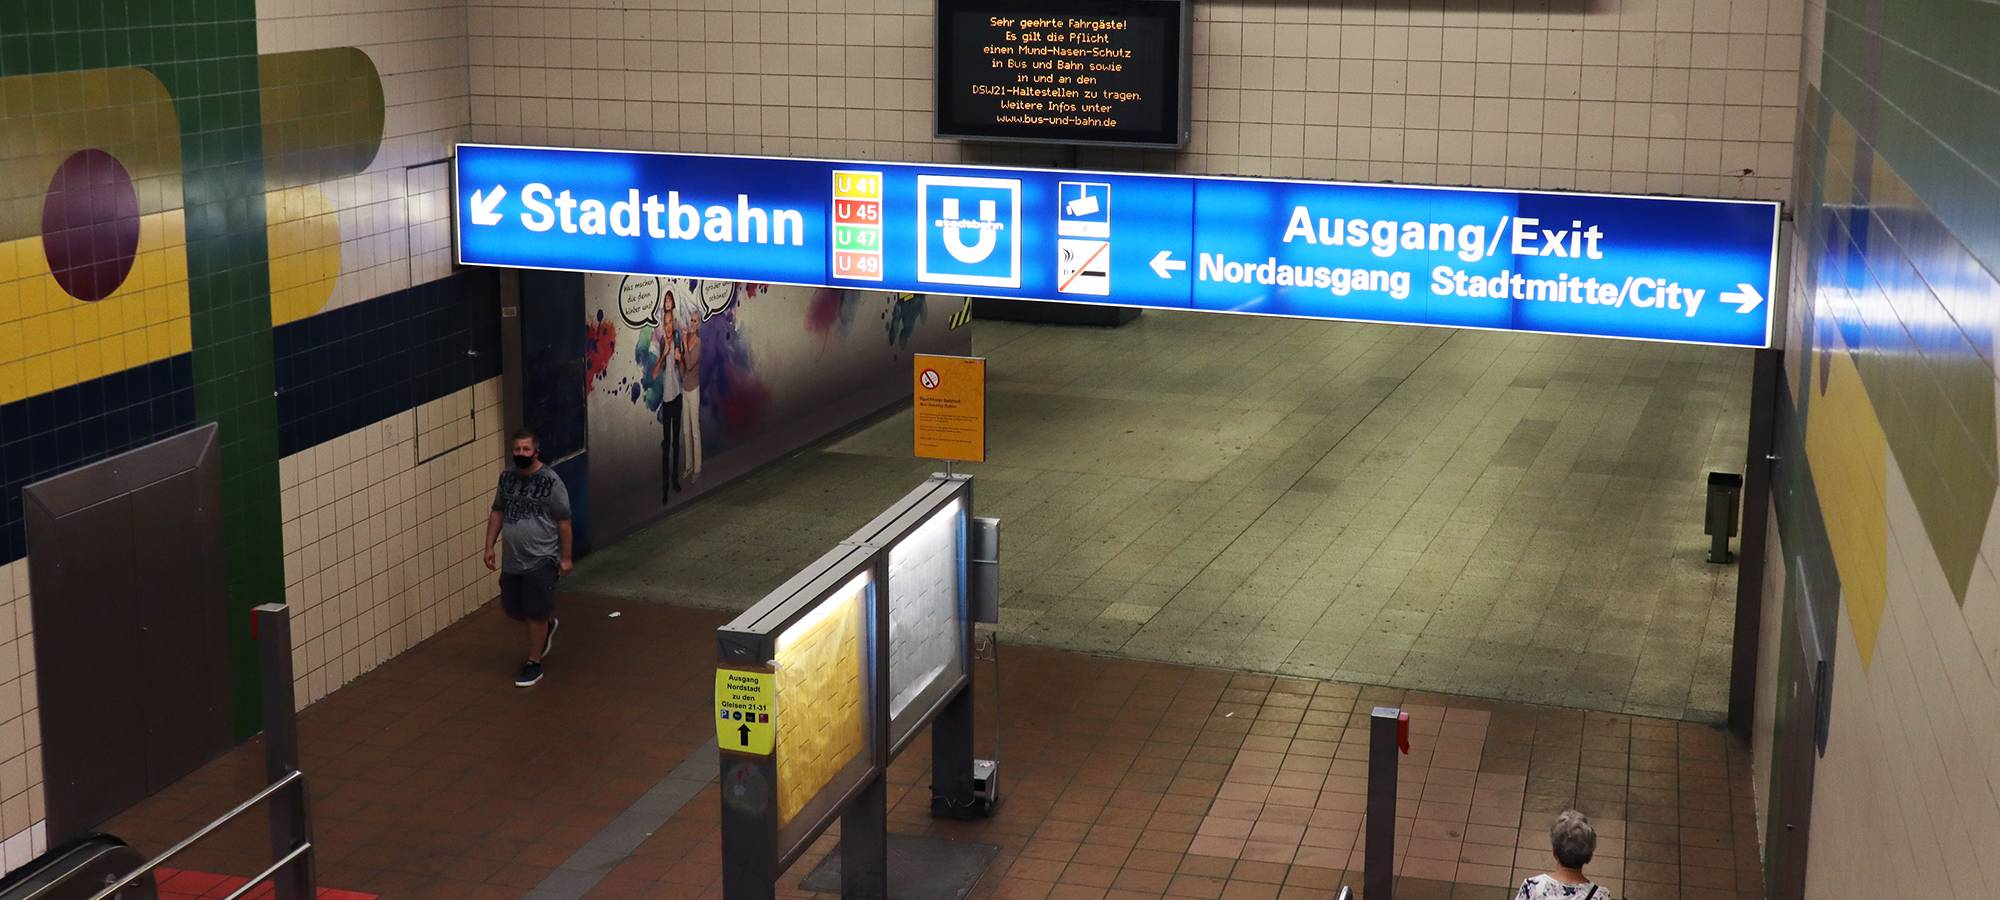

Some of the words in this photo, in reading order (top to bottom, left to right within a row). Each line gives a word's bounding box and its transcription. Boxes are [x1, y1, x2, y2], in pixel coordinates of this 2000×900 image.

[989, 16, 1015, 28] Sehr
[1019, 17, 1064, 30] geehrte
[1068, 18, 1127, 32] Fahrgäste!
[1005, 30, 1018, 41] Es
[1021, 31, 1042, 44] gilt
[1046, 31, 1065, 43] die
[1069, 32, 1110, 45] Pflicht
[983, 44, 1014, 55] einen
[1018, 44, 1132, 59] Mund-Nasen-Schutz
[991, 58, 1004, 68] in
[1007, 58, 1028, 69] Bus
[1032, 59, 1053, 70] und
[1056, 59, 1084, 71] Bahn
[1088, 61, 1123, 72] sowie
[1017, 72, 1029, 83] in
[1033, 73, 1054, 84] und
[1057, 75, 1072, 84] an
[1076, 74, 1097, 85] den
[972, 84, 1080, 98] DSW21-Haltestellen
[1083, 90, 1098, 99] zu
[1102, 89, 1142, 103] tragen.
[1000, 99, 1044, 111] Weitere
[1048, 100, 1077, 114] Infos
[1081, 102, 1113, 113] unter
[996, 113, 1117, 128] www.bus-und-bahn.de
[838, 176, 851, 193] U
[856, 178, 875, 194] 41
[520, 183, 803, 246] Stadtbahn
[838, 203, 851, 219] U
[856, 204, 878, 220] 45
[839, 229, 851, 246] U
[857, 230, 877, 247] 47
[1283, 206, 1603, 262] Ausgang/Exit
[839, 255, 852, 272] U
[857, 256, 878, 273] 49
[1199, 253, 1410, 300] Nordausgang
[1431, 265, 1705, 317] Stadtmitte/City
[728, 674, 758, 684] Ausgang
[727, 683, 760, 692] Nordstadt
[721, 701, 746, 709] Gleisen
